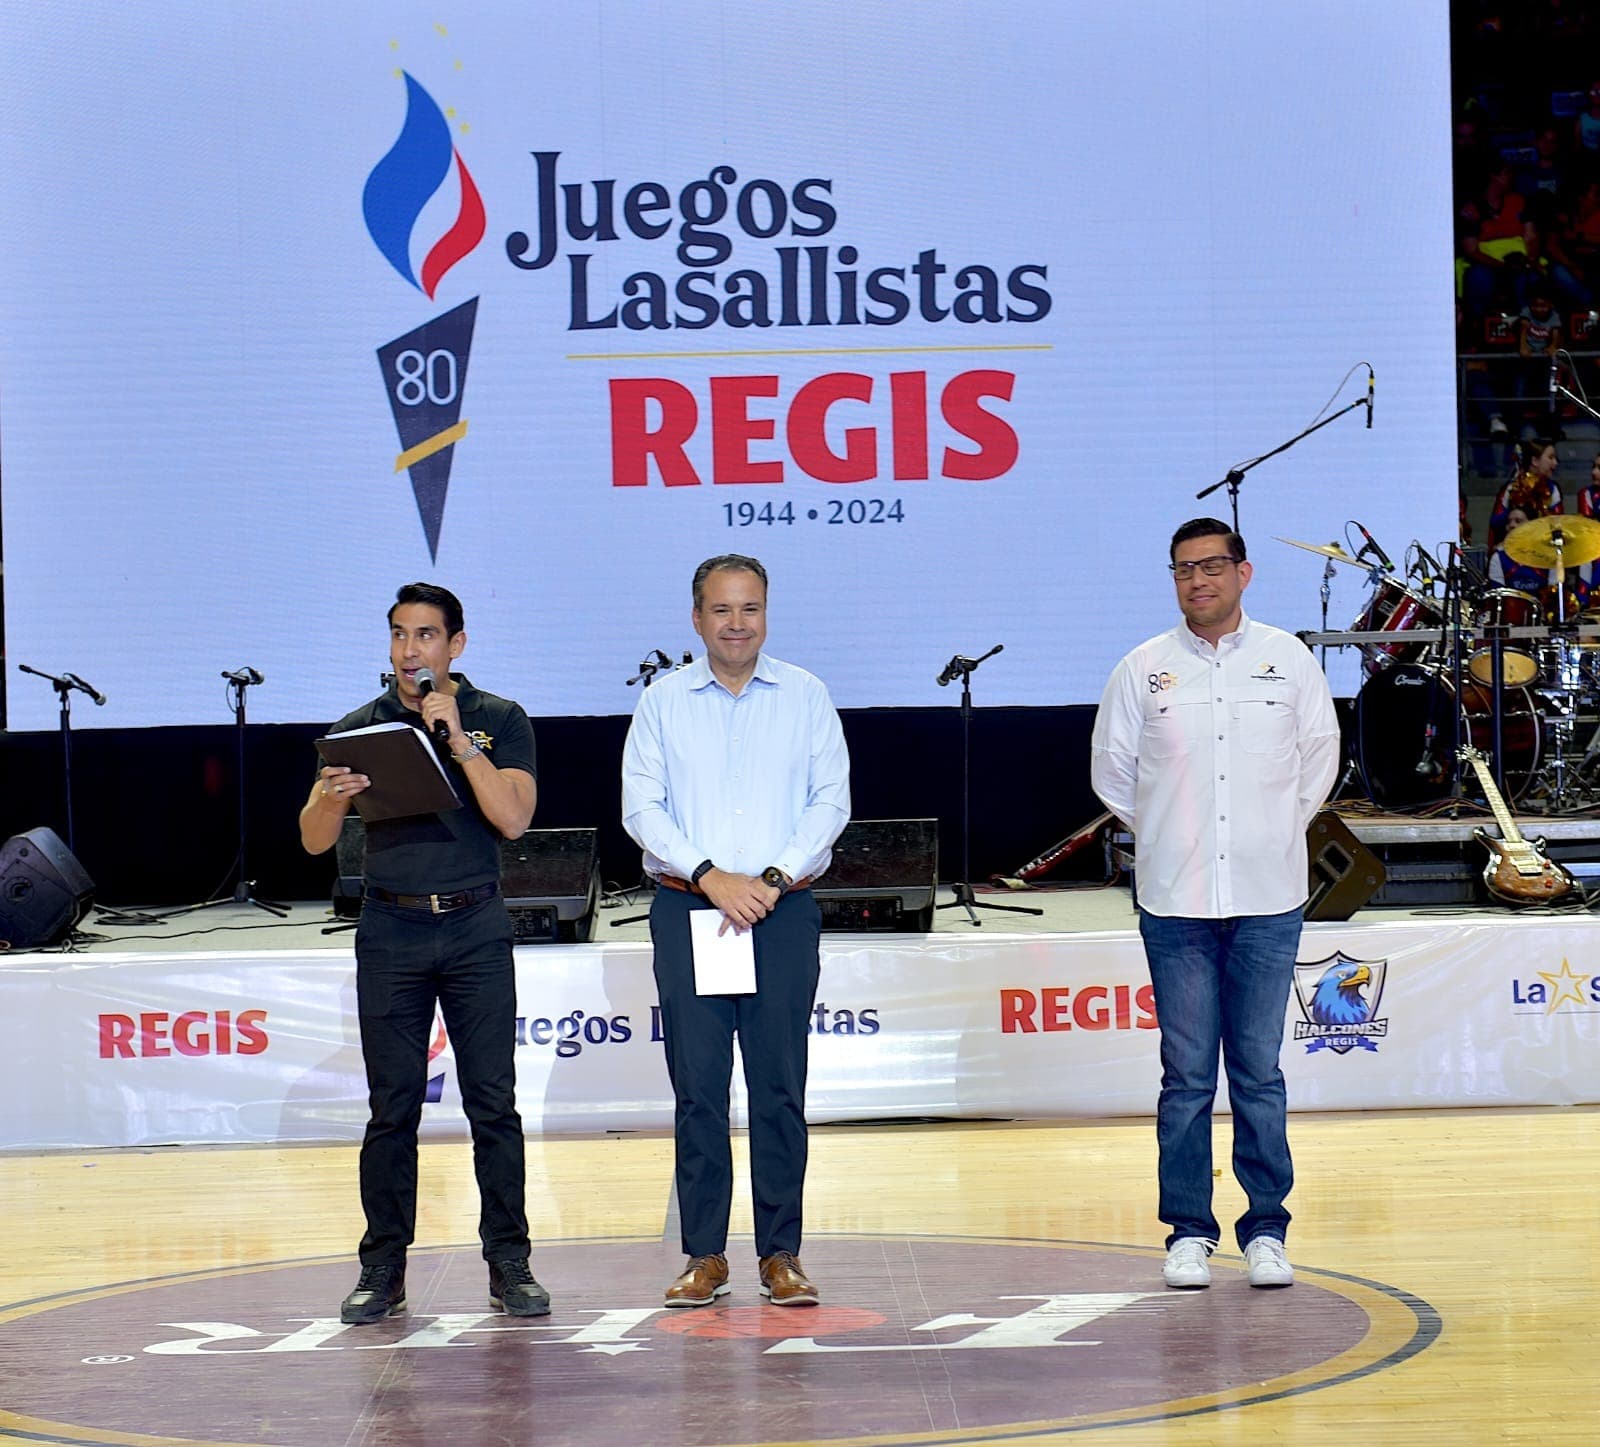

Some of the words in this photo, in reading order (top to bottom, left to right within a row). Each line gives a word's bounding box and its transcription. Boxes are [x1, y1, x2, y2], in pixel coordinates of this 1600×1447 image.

[506, 151, 838, 270] Juegos
[566, 246, 1053, 331] Lasallistas
[396, 350, 456, 406] 80
[609, 369, 1019, 487] REGIS
[723, 501, 796, 527] 1944
[827, 498, 905, 525] 2024
[99, 1010, 269, 1059] REGIS
[1295, 1020, 1387, 1038] HALCONES
[1325, 1037, 1359, 1046] REGIS
